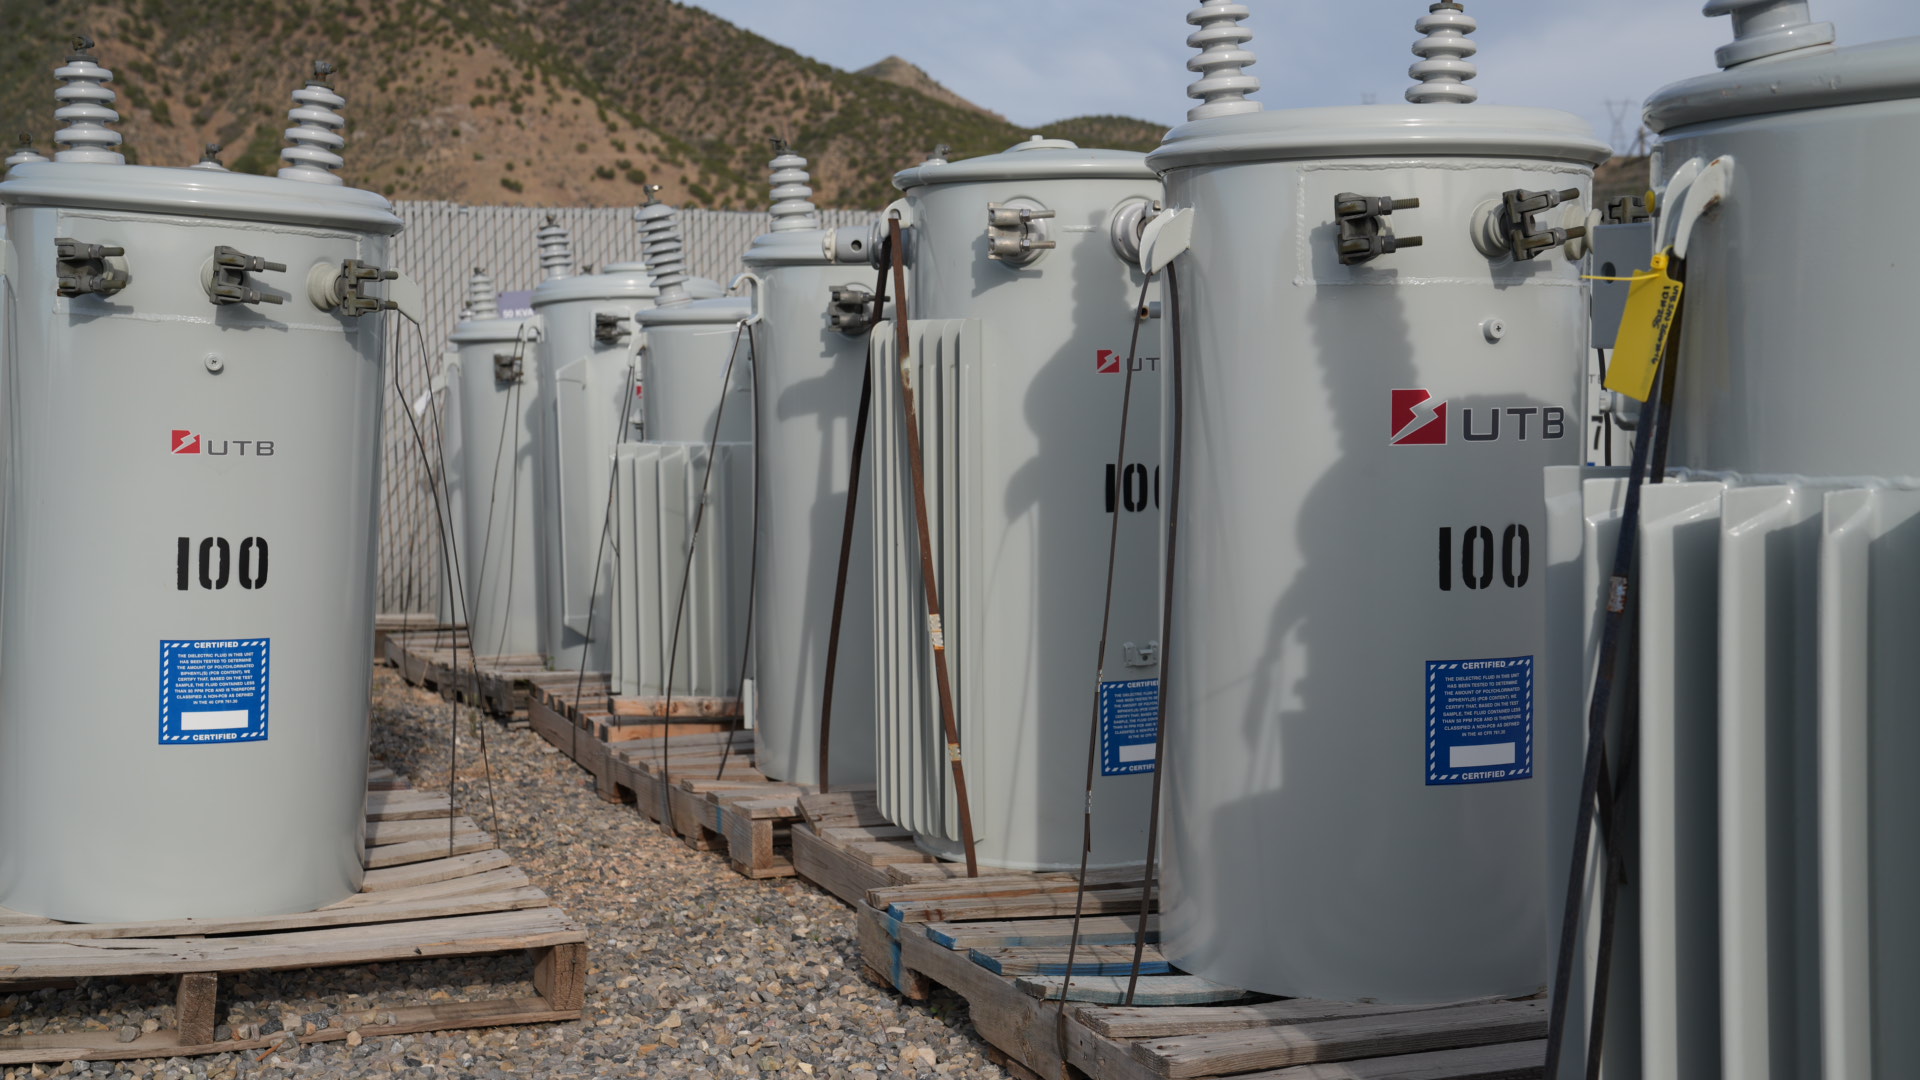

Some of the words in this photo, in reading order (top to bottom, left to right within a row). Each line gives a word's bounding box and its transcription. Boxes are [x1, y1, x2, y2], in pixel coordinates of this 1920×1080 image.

[1126, 357, 1161, 372] UT
[1463, 407, 1564, 441] UTB
[208, 440, 274, 456] UTB
[177, 536, 268, 591] 100
[1439, 523, 1529, 591] 100
[1462, 660, 1506, 670] CERTIFIED
[192, 733, 237, 741] CERTIFIED
[1462, 770, 1505, 780] CERTIFIED
